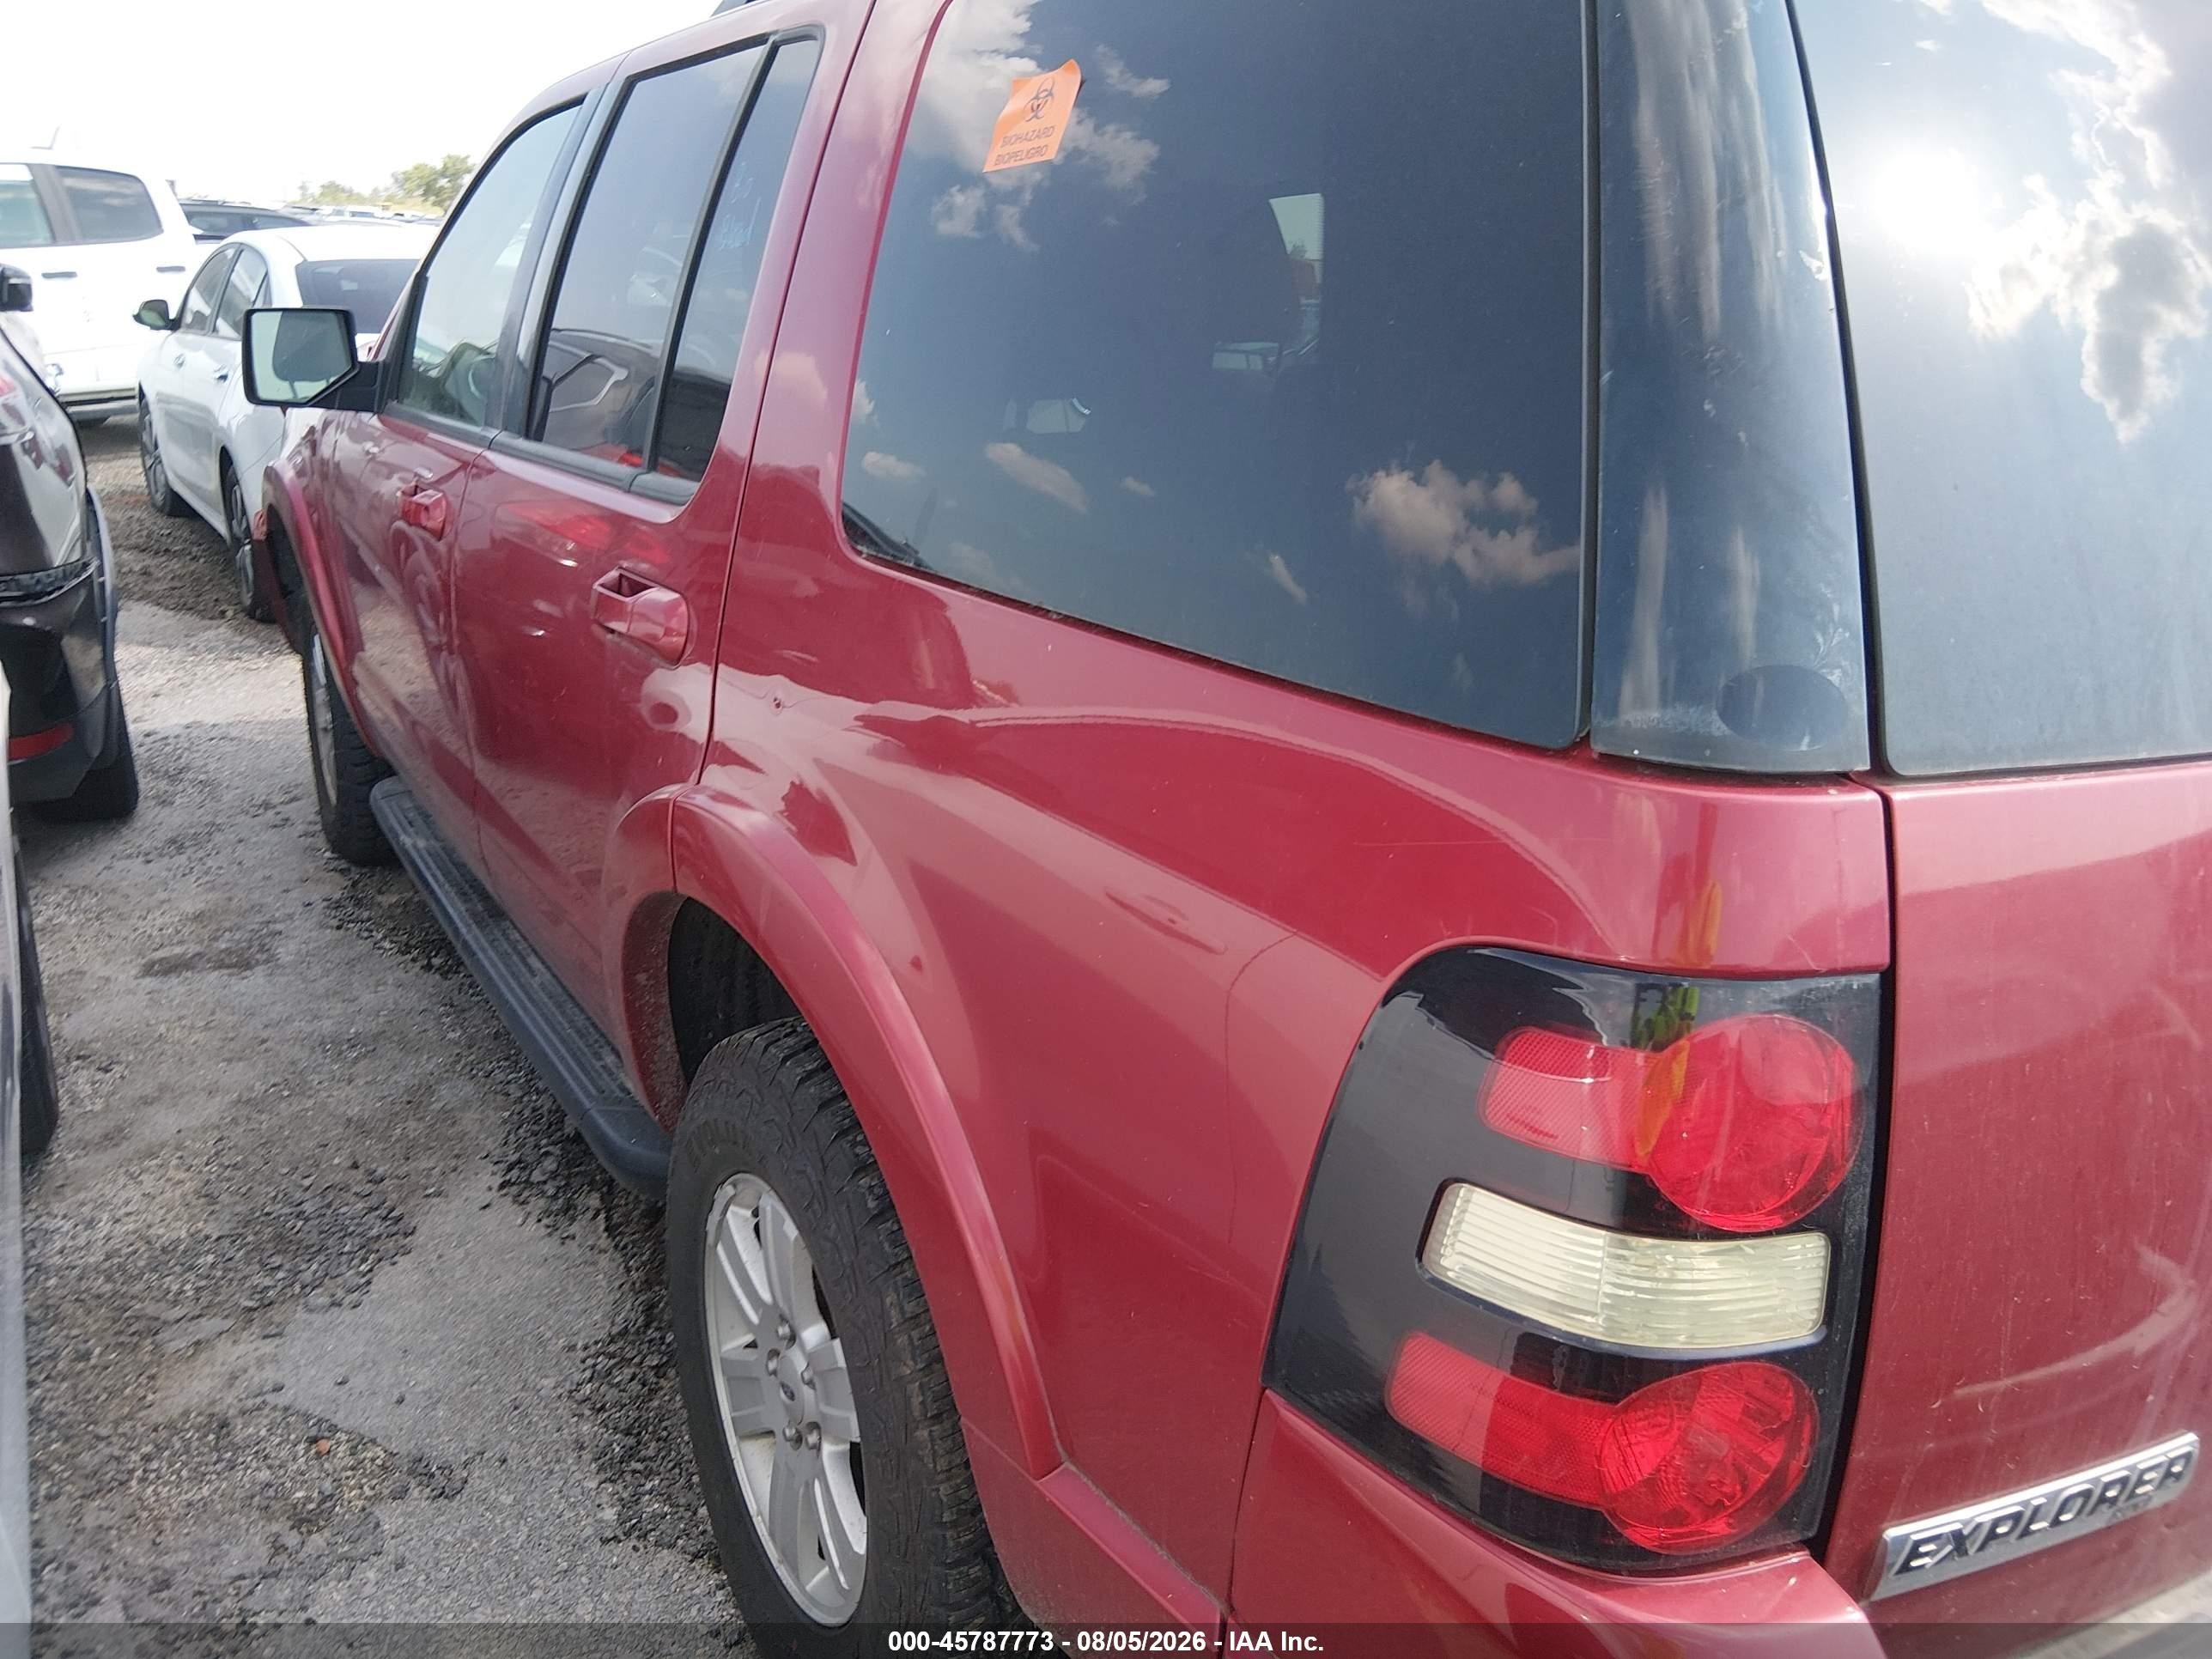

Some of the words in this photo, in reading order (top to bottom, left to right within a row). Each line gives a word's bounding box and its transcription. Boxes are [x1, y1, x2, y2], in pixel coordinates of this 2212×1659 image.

[1001, 125, 1055, 147] BIOHAZARD
[994, 144, 1048, 165] BIOPELIGRO
[1891, 1444, 2197, 1577] EXPLORER
